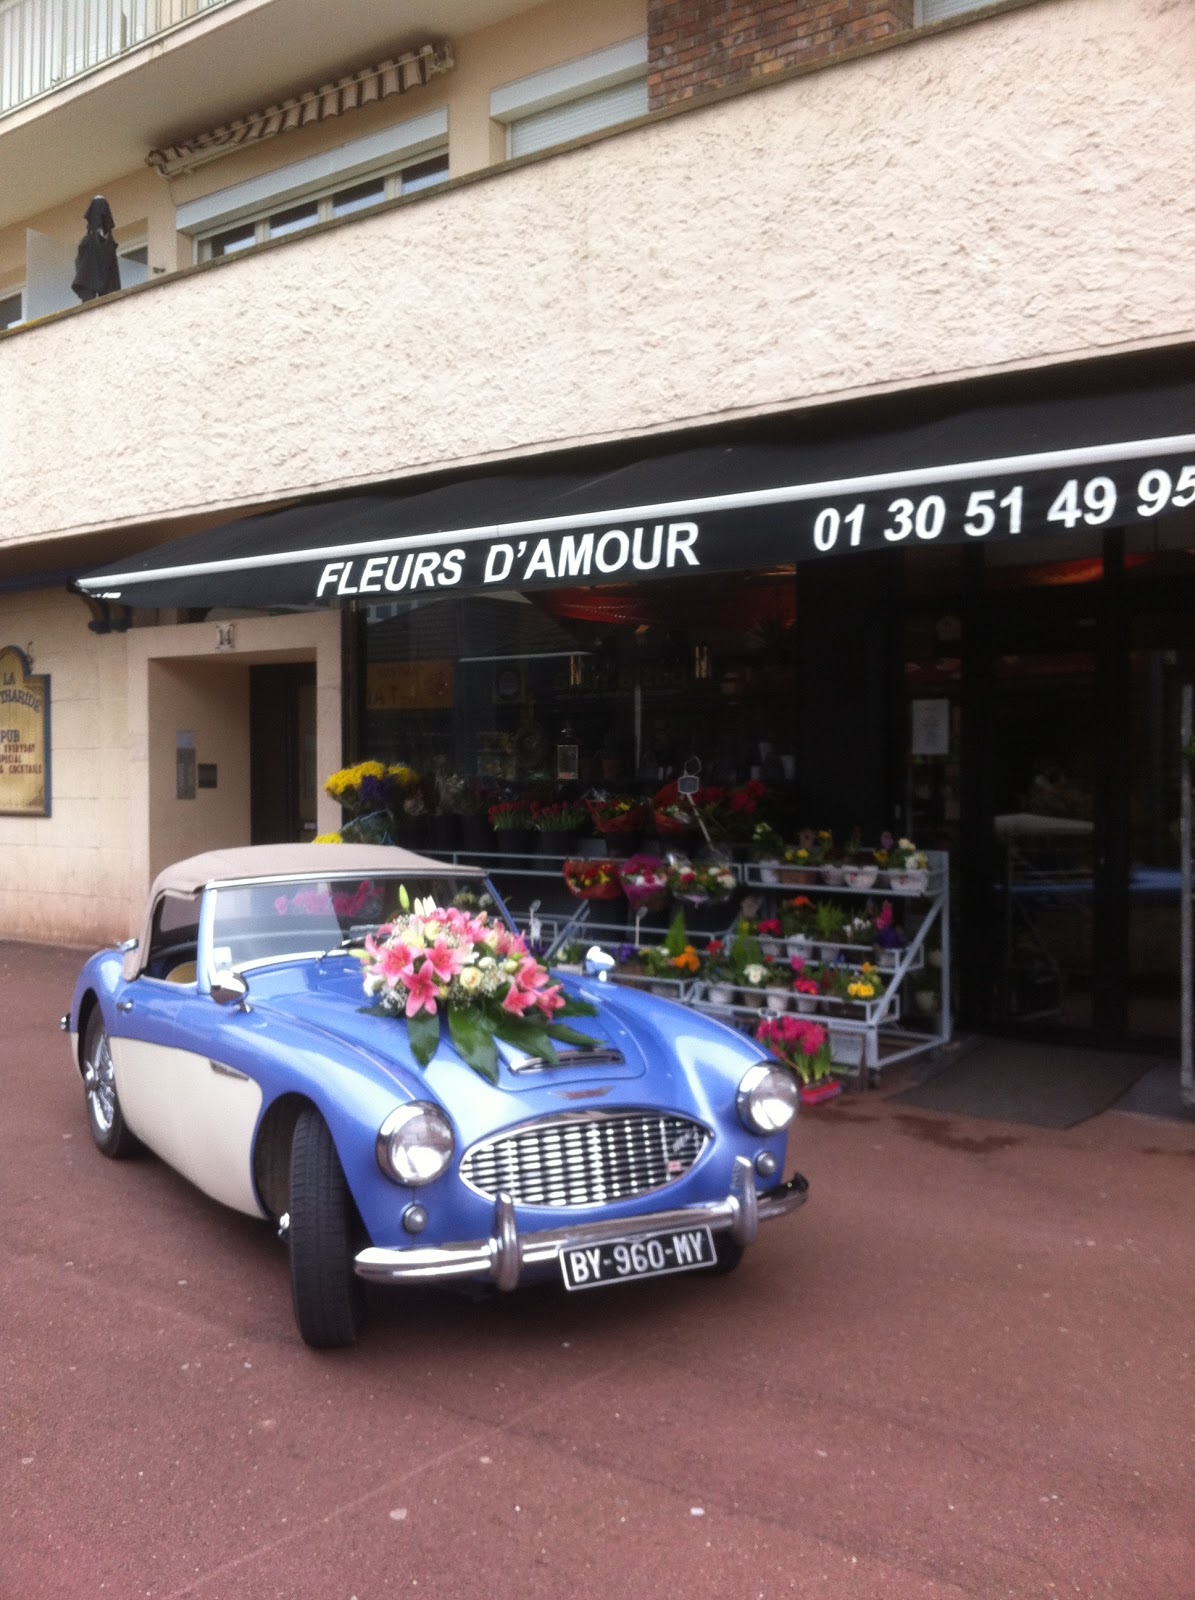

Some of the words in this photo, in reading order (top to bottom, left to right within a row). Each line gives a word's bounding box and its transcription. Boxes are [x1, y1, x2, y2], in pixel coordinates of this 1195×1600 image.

[813, 503, 866, 552] 01
[883, 495, 946, 541] 30
[963, 485, 1024, 537] 51
[1047, 476, 1118, 528] 49
[1136, 464, 1195, 517] 95
[316, 548, 466, 598] FLEURS
[483, 522, 701, 584] D'AMOUR
[0, 729, 20, 743] PUB
[569, 1231, 702, 1283] BY-960-MY
